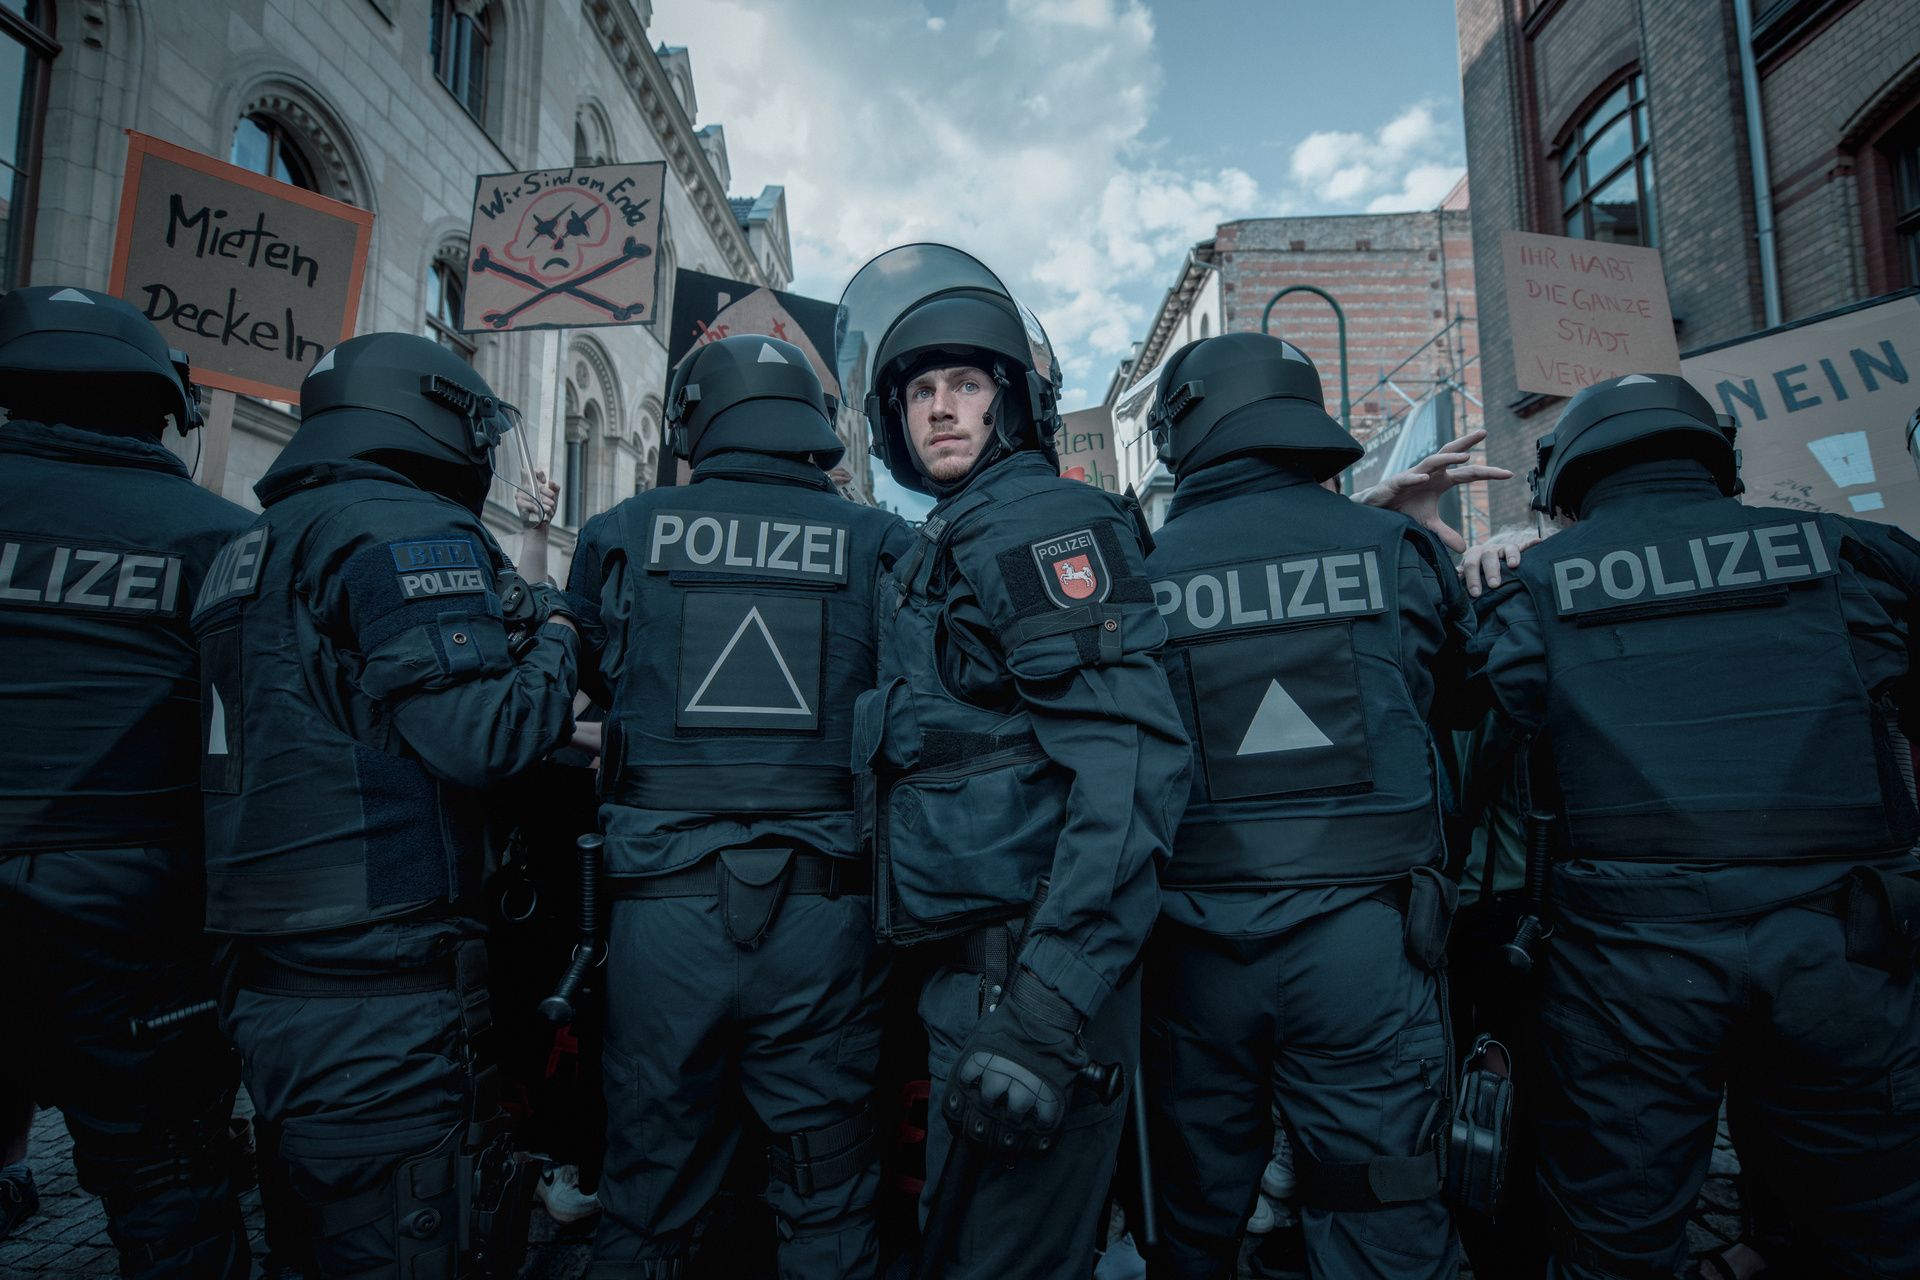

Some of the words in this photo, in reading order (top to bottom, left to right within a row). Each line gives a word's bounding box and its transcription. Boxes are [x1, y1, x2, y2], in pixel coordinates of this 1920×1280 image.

[479, 186, 522, 220] Wir
[523, 169, 573, 195] Sind
[577, 176, 605, 193] am
[606, 177, 651, 228] Ende
[166, 193, 319, 288] Mieten
[1520, 246, 1559, 269] IHR
[1570, 253, 1634, 282] HABT
[142, 283, 325, 362] Deckeln
[1526, 279, 1567, 305] DIE
[1572, 289, 1652, 319] GANZE
[1558, 318, 1630, 355] STADT
[1536, 355, 1617, 386] VERK
[1715, 339, 1910, 428] NEIN
[650, 515, 845, 576] POLIZEI
[1038, 535, 1092, 560] POLIZEI
[1553, 520, 1831, 610] POLIZEI
[0, 542, 182, 611] LIZEI
[402, 570, 486, 597] POLIZEI
[1151, 551, 1384, 629] POLIZEI
